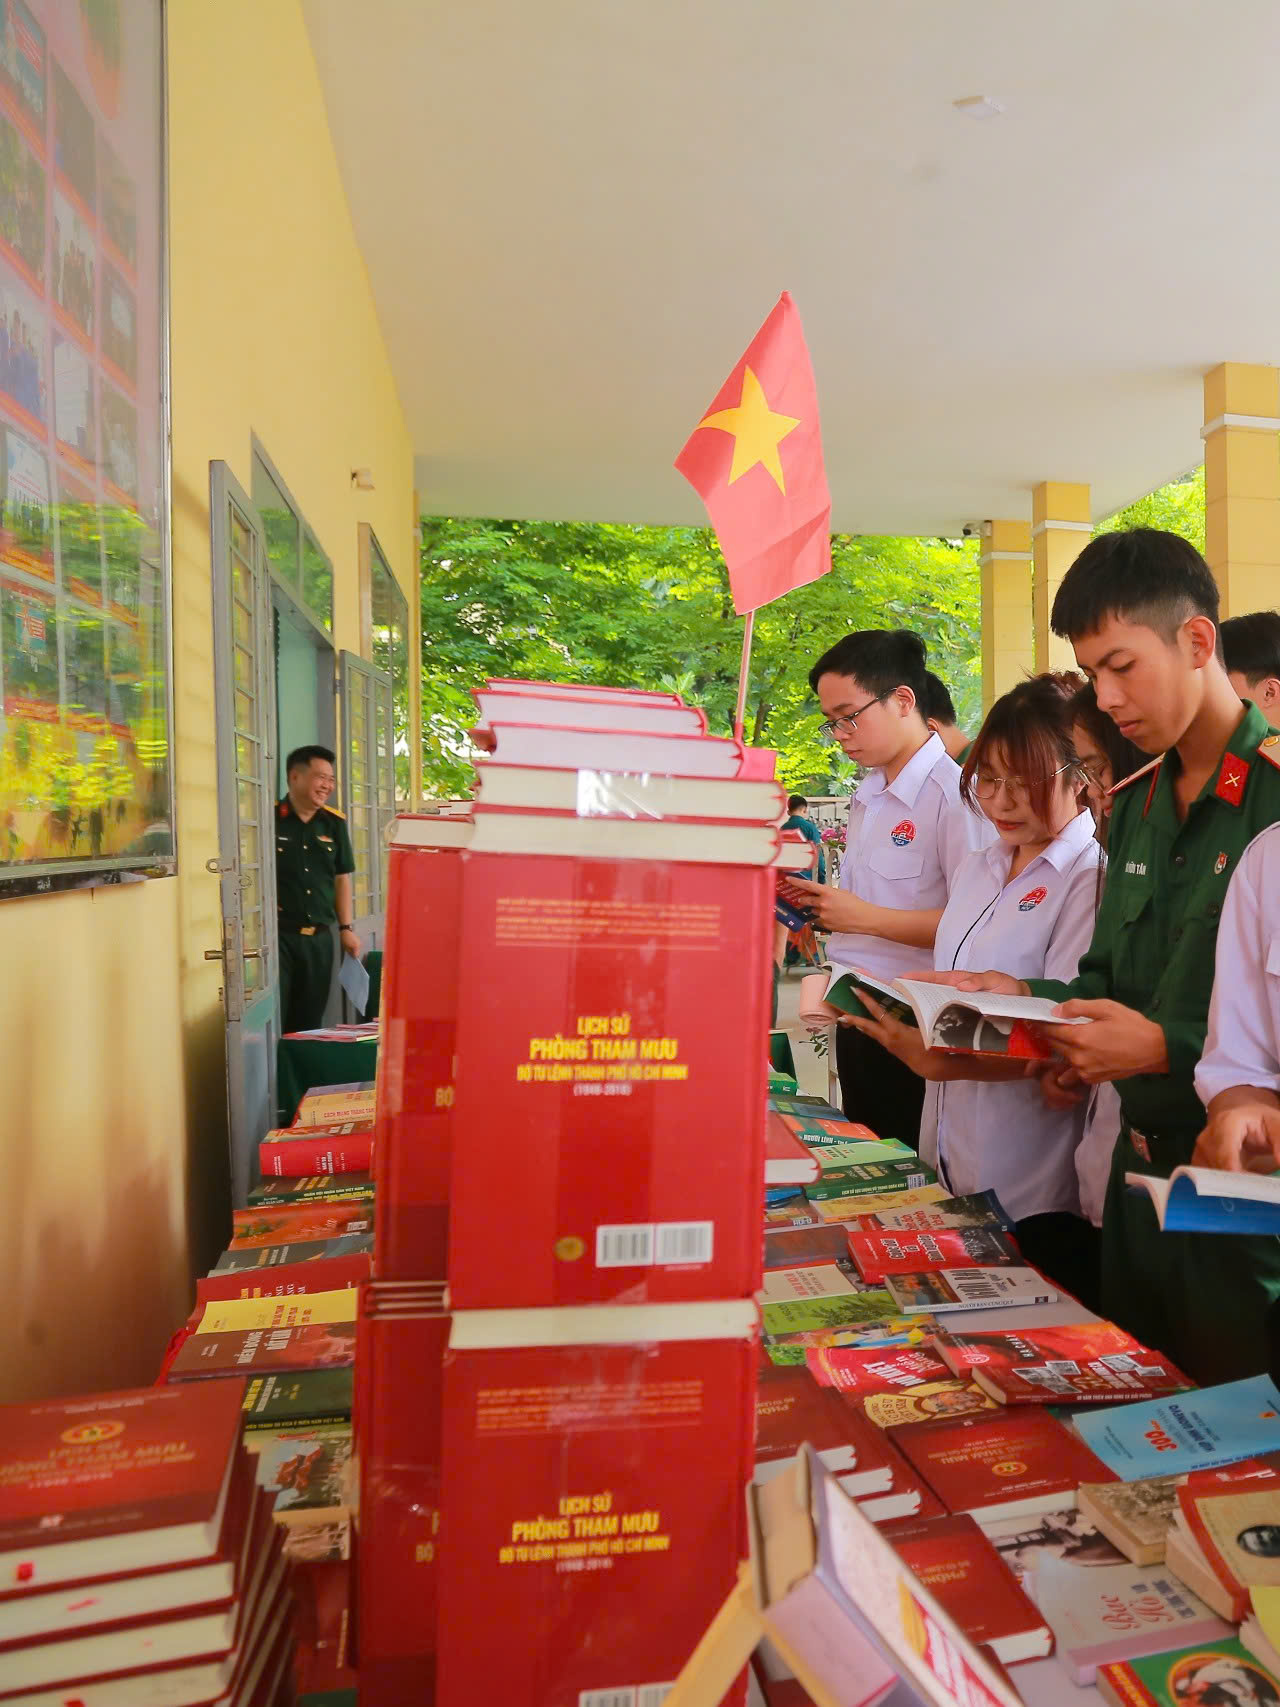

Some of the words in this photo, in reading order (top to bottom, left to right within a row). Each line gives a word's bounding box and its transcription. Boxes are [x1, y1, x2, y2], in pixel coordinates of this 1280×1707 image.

[577, 1016, 609, 1039] LỊCH
[611, 1013, 630, 1034] SỬ
[529, 1034, 588, 1060] PHÒNG
[591, 1039, 636, 1060] THAM
[640, 1038, 678, 1060] MƯU
[1141, 1428, 1179, 1453] 300
[559, 1496, 590, 1519] LỊCH
[592, 1491, 612, 1513] SỬ
[512, 1515, 569, 1543] PHÒNG
[573, 1516, 618, 1539] THAM
[622, 1512, 660, 1533] MƯU
